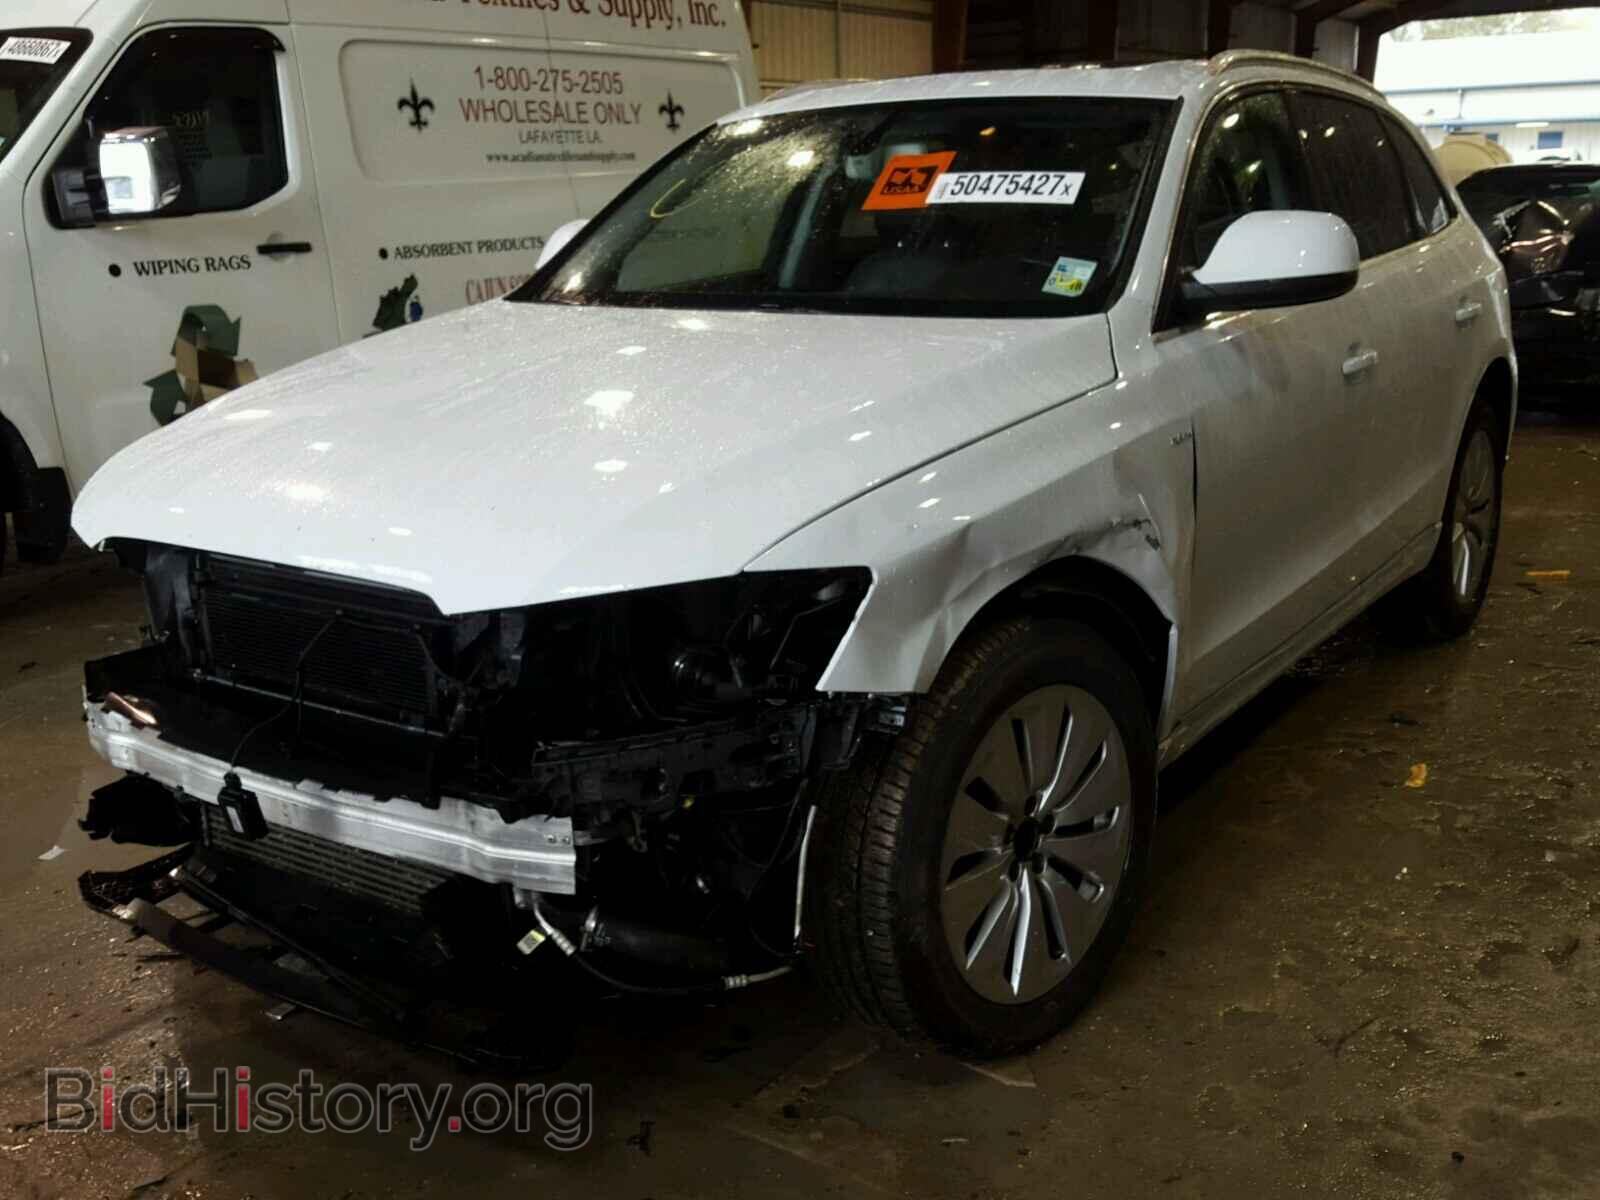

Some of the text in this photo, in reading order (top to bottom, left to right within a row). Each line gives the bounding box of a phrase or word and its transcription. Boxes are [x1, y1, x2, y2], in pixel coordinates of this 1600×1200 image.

[474, 65, 624, 95] 1-800-275-2505
[458, 97, 642, 125] WHOLESALE ONLY
[518, 129, 585, 144] LAFAYETTE
[394, 235, 546, 260] ABSORBENT PRODUCTS
[133, 255, 251, 277] WIPING RAGS
